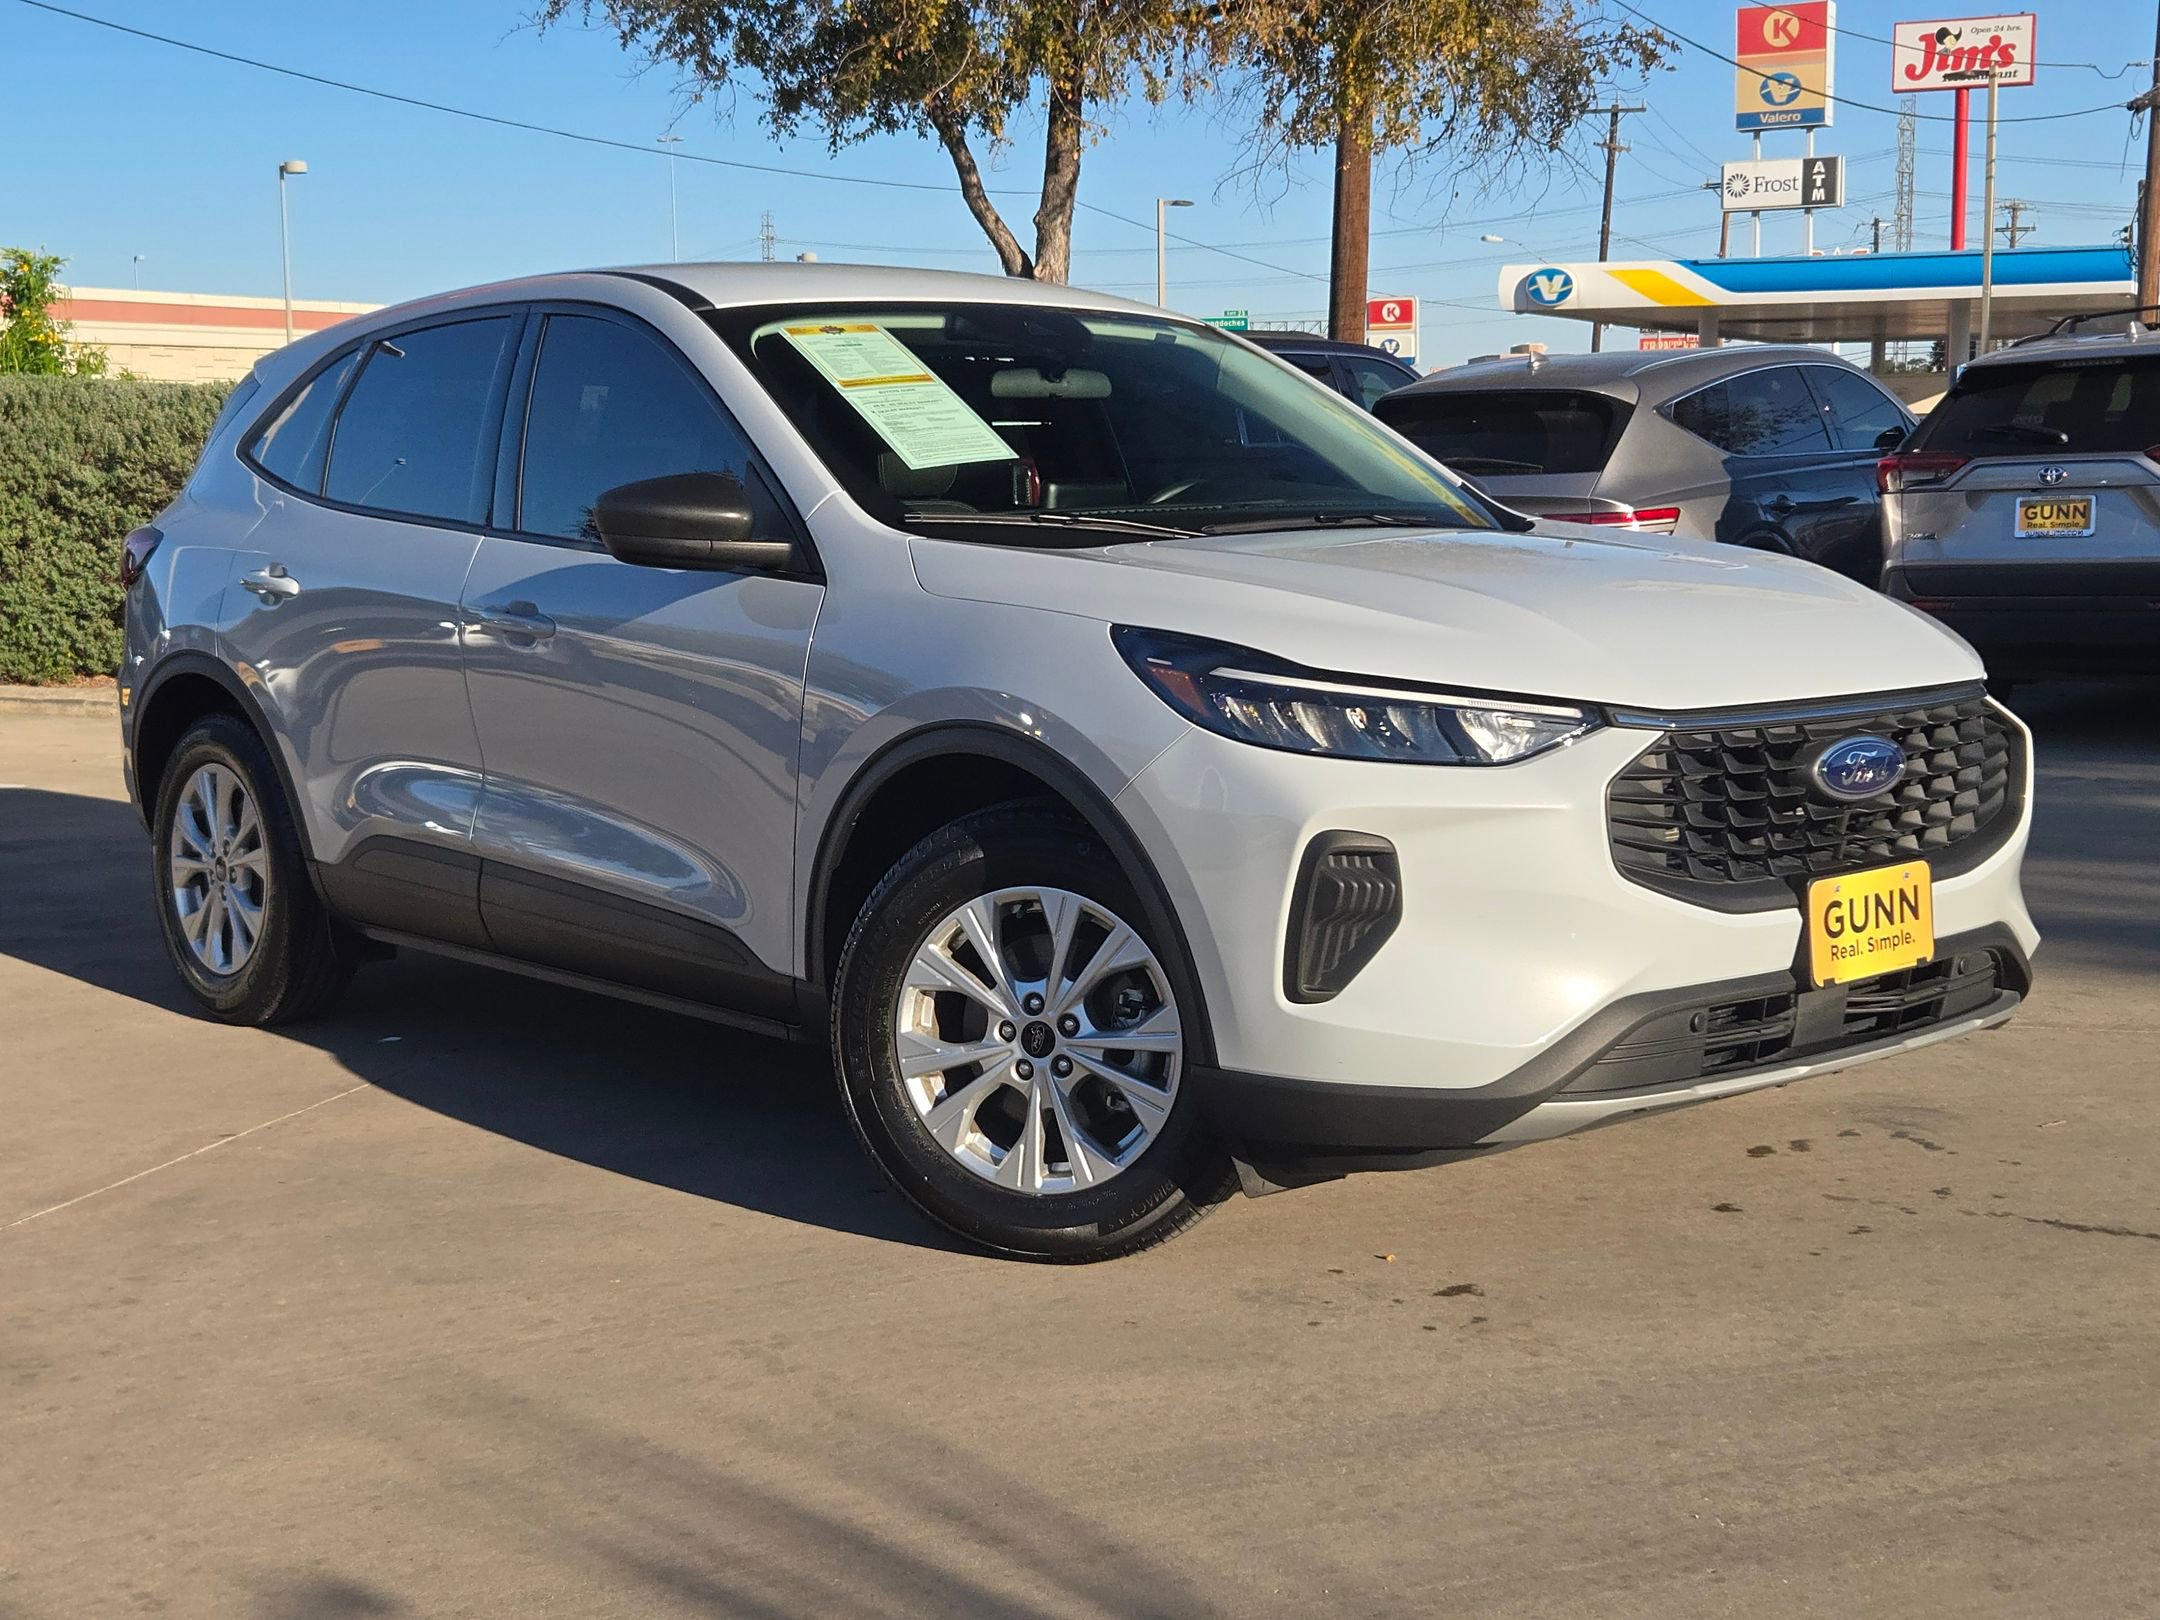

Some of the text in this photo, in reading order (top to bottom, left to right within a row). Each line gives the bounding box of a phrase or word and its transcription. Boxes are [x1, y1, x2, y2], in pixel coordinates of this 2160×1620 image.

[1970, 24, 2023, 35] Open 24 hrs.
[1904, 33, 2017, 81] Jim's
[1760, 112, 1801, 124] Valero
[1753, 176, 1799, 193] Frost
[1812, 160, 1826, 201] ATM
[1207, 319, 1246, 328] ogdoches
[2024, 504, 2087, 520] GUNN
[2027, 521, 2048, 529] Real.
[1824, 884, 1920, 939] GUNN
[1830, 929, 1916, 962] Real. Simple.
